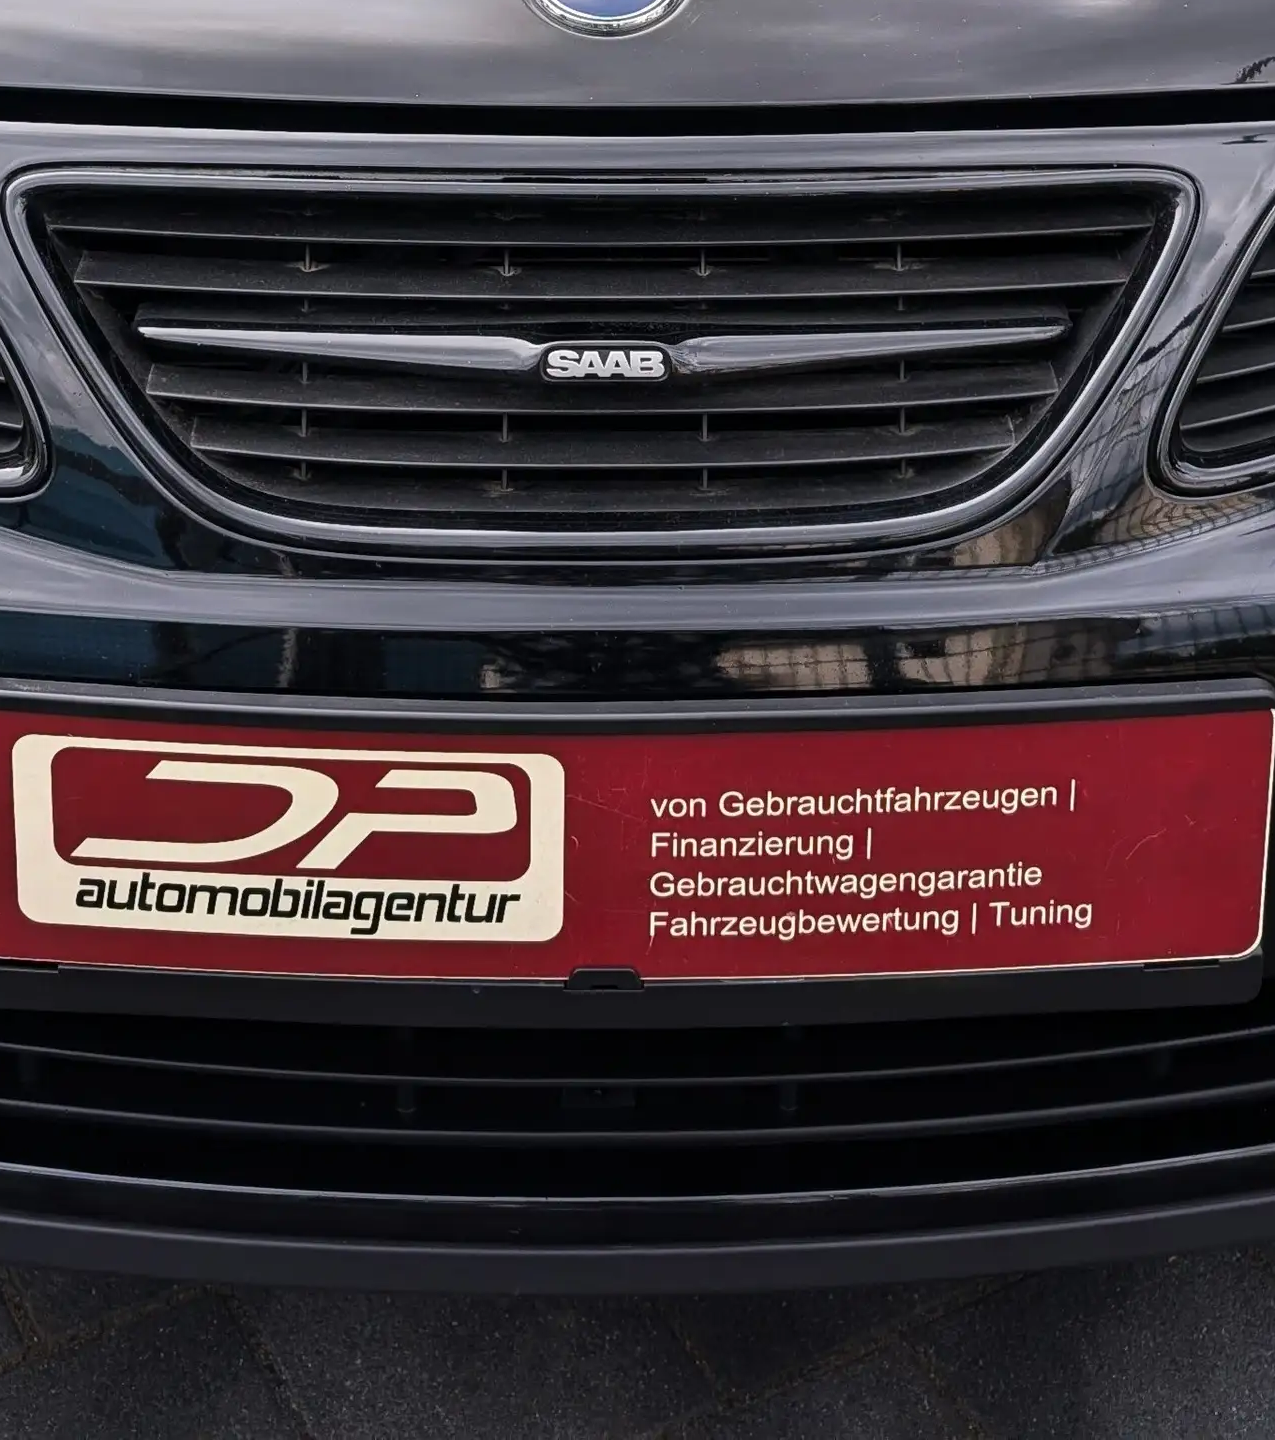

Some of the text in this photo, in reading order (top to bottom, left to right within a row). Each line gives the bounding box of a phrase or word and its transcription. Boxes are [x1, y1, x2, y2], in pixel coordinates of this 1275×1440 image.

[546, 350, 665, 378] SAAB
[650, 796, 707, 818] von
[718, 782, 1058, 817] Gebrauchtfahrzeugen
[650, 829, 854, 860] Finanzierung
[649, 862, 1043, 899] Gebrauchtwagengarantie
[75, 872, 521, 936] automobilagentur
[648, 907, 960, 941] Fahrzeugbewertung
[989, 901, 1093, 928] Tuning
